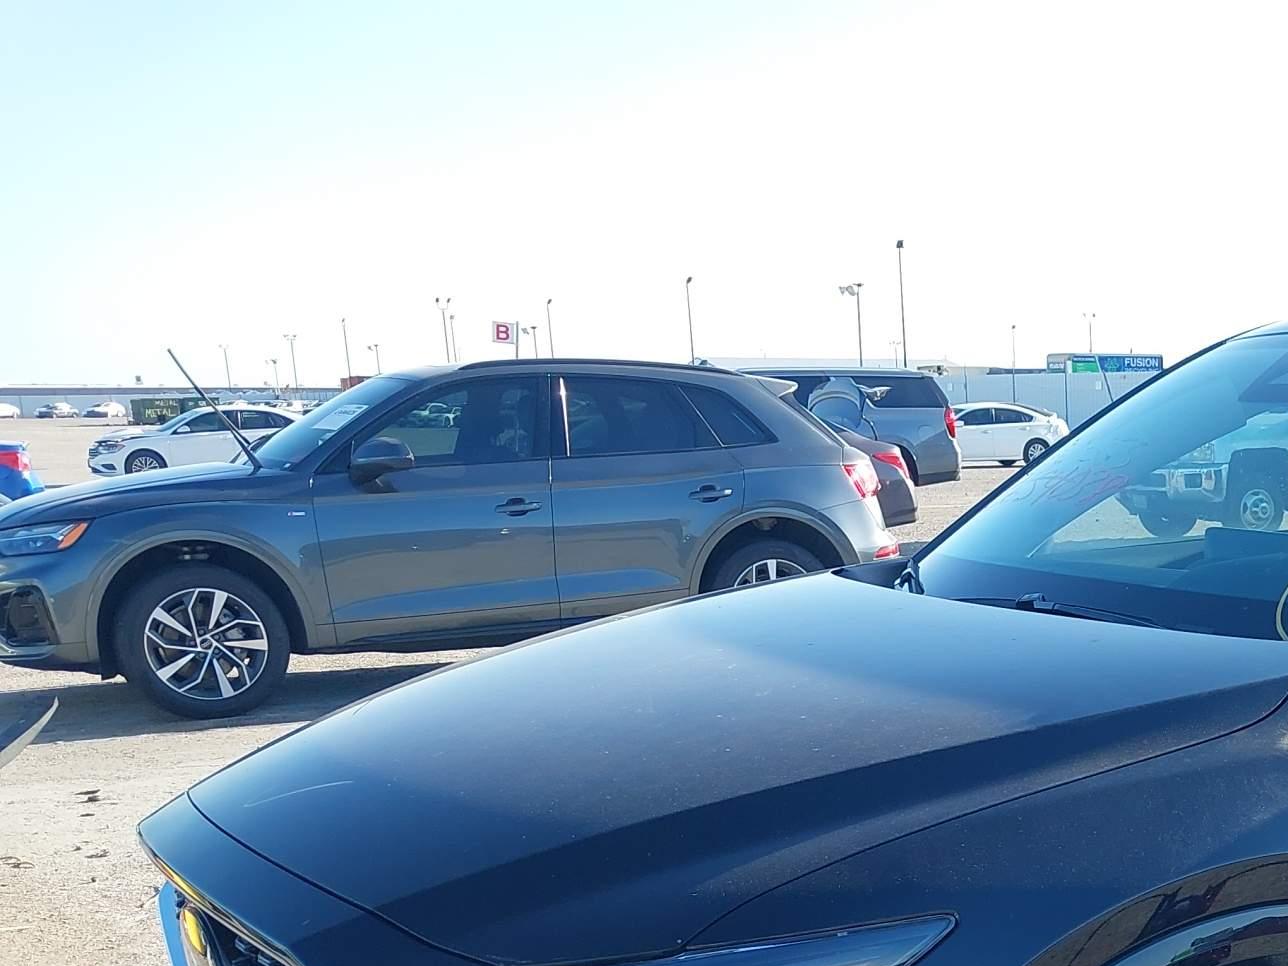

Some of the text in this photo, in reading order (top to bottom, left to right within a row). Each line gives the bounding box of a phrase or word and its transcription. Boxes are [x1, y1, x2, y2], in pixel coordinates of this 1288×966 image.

[496, 324, 510, 341] B
[1124, 357, 1159, 368] FUSION
[145, 408, 177, 418] METAL
